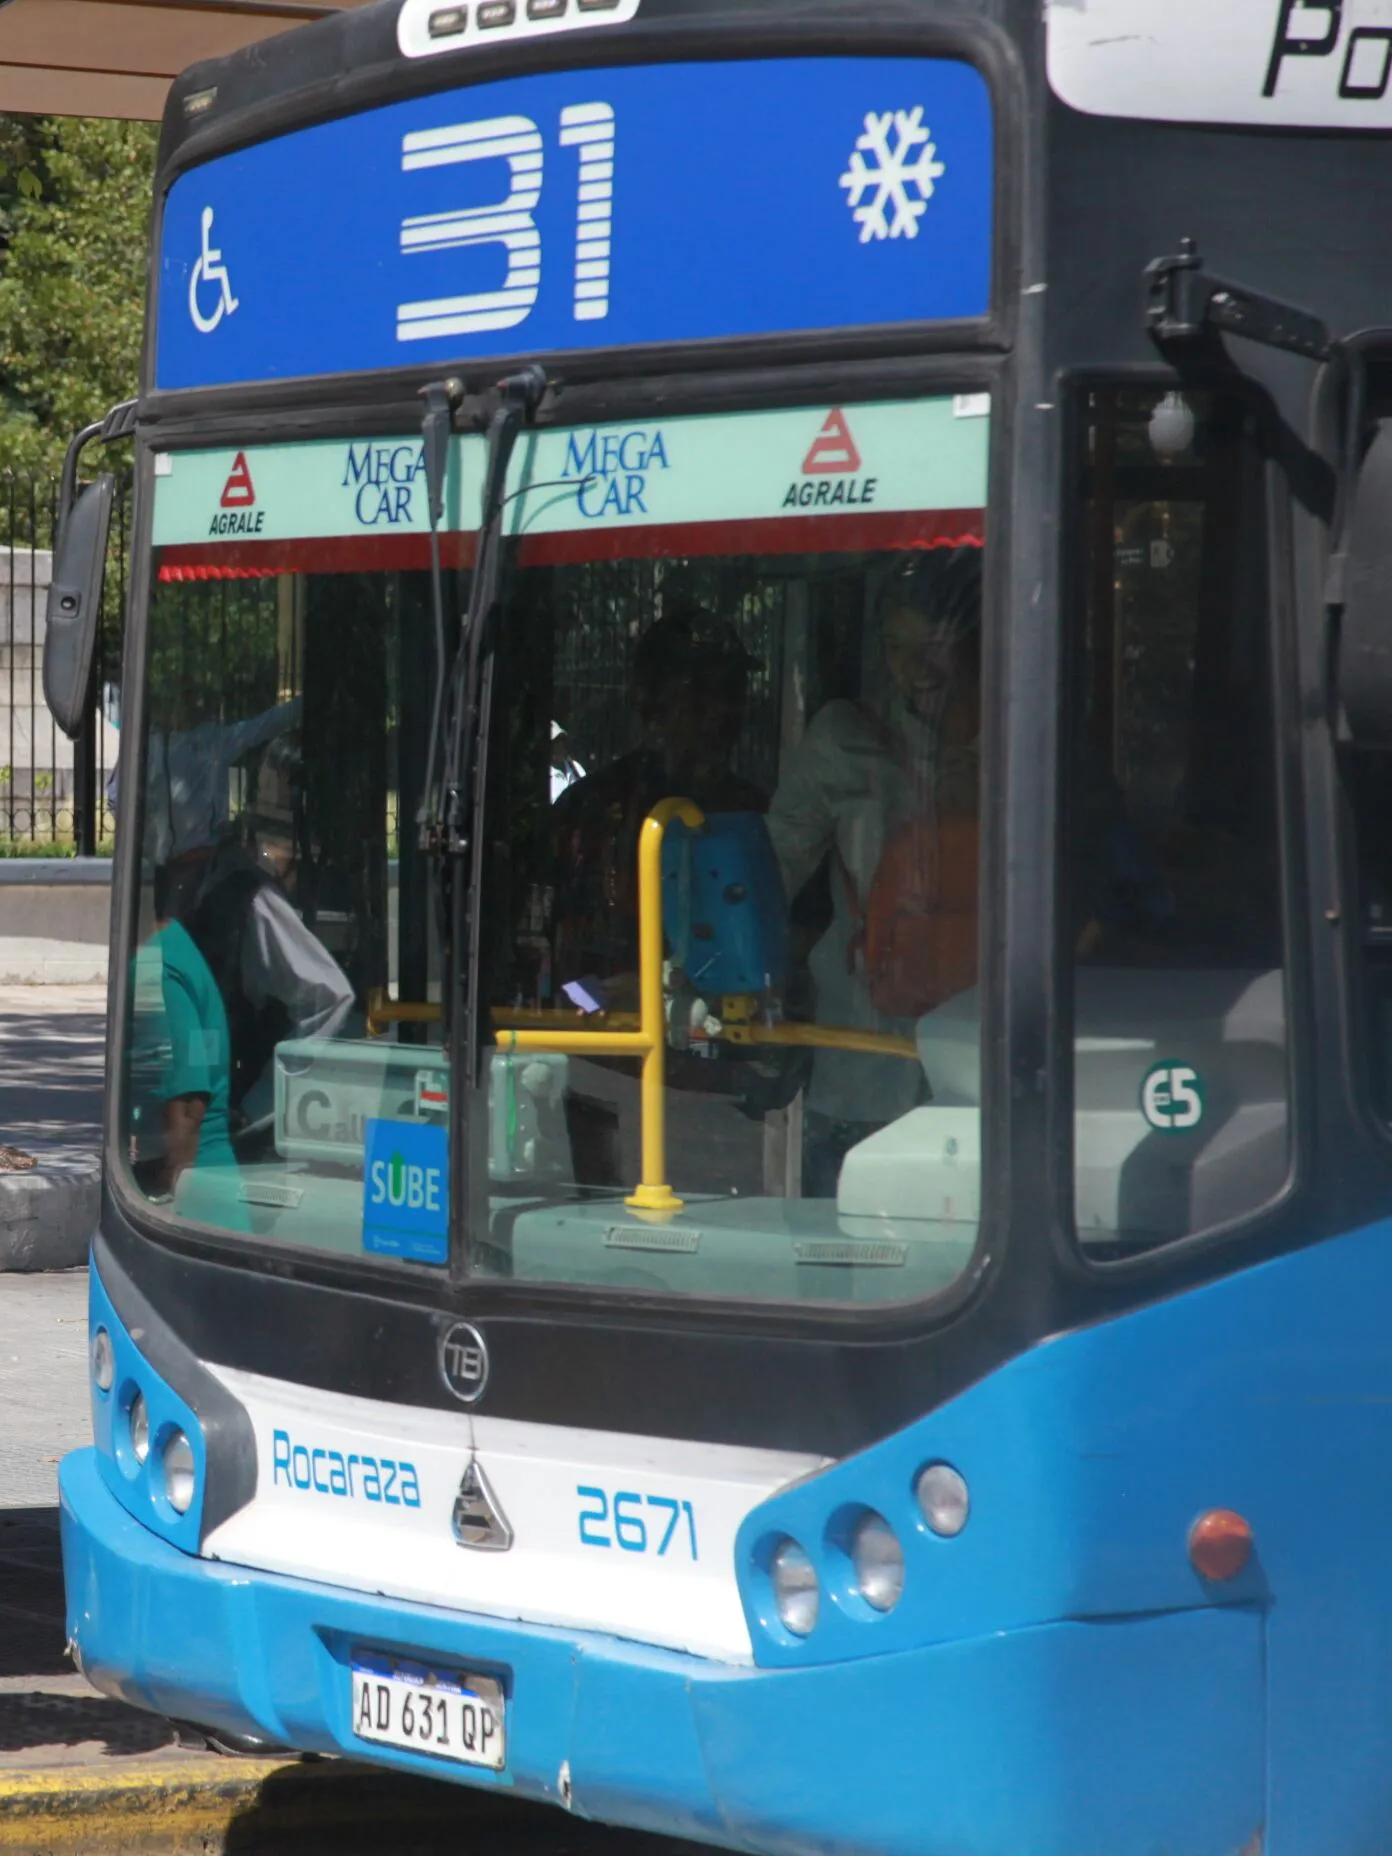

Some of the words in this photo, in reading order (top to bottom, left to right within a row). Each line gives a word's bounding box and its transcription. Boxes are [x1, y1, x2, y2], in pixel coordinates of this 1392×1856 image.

[396, 102, 615, 341] 31
[560, 429, 670, 478] MEGA
[355, 483, 413, 526] CAR
[577, 472, 649, 519] CAR
[783, 478, 878, 508] AGRALE
[209, 511, 266, 536] AGRALE
[371, 1160, 441, 1211] SUBE
[273, 1429, 421, 1509] Rocaraza
[577, 1485, 698, 1561] 2671
[361, 1682, 390, 1730] AD
[402, 1692, 449, 1745] 631
[462, 1704, 494, 1753] QP
